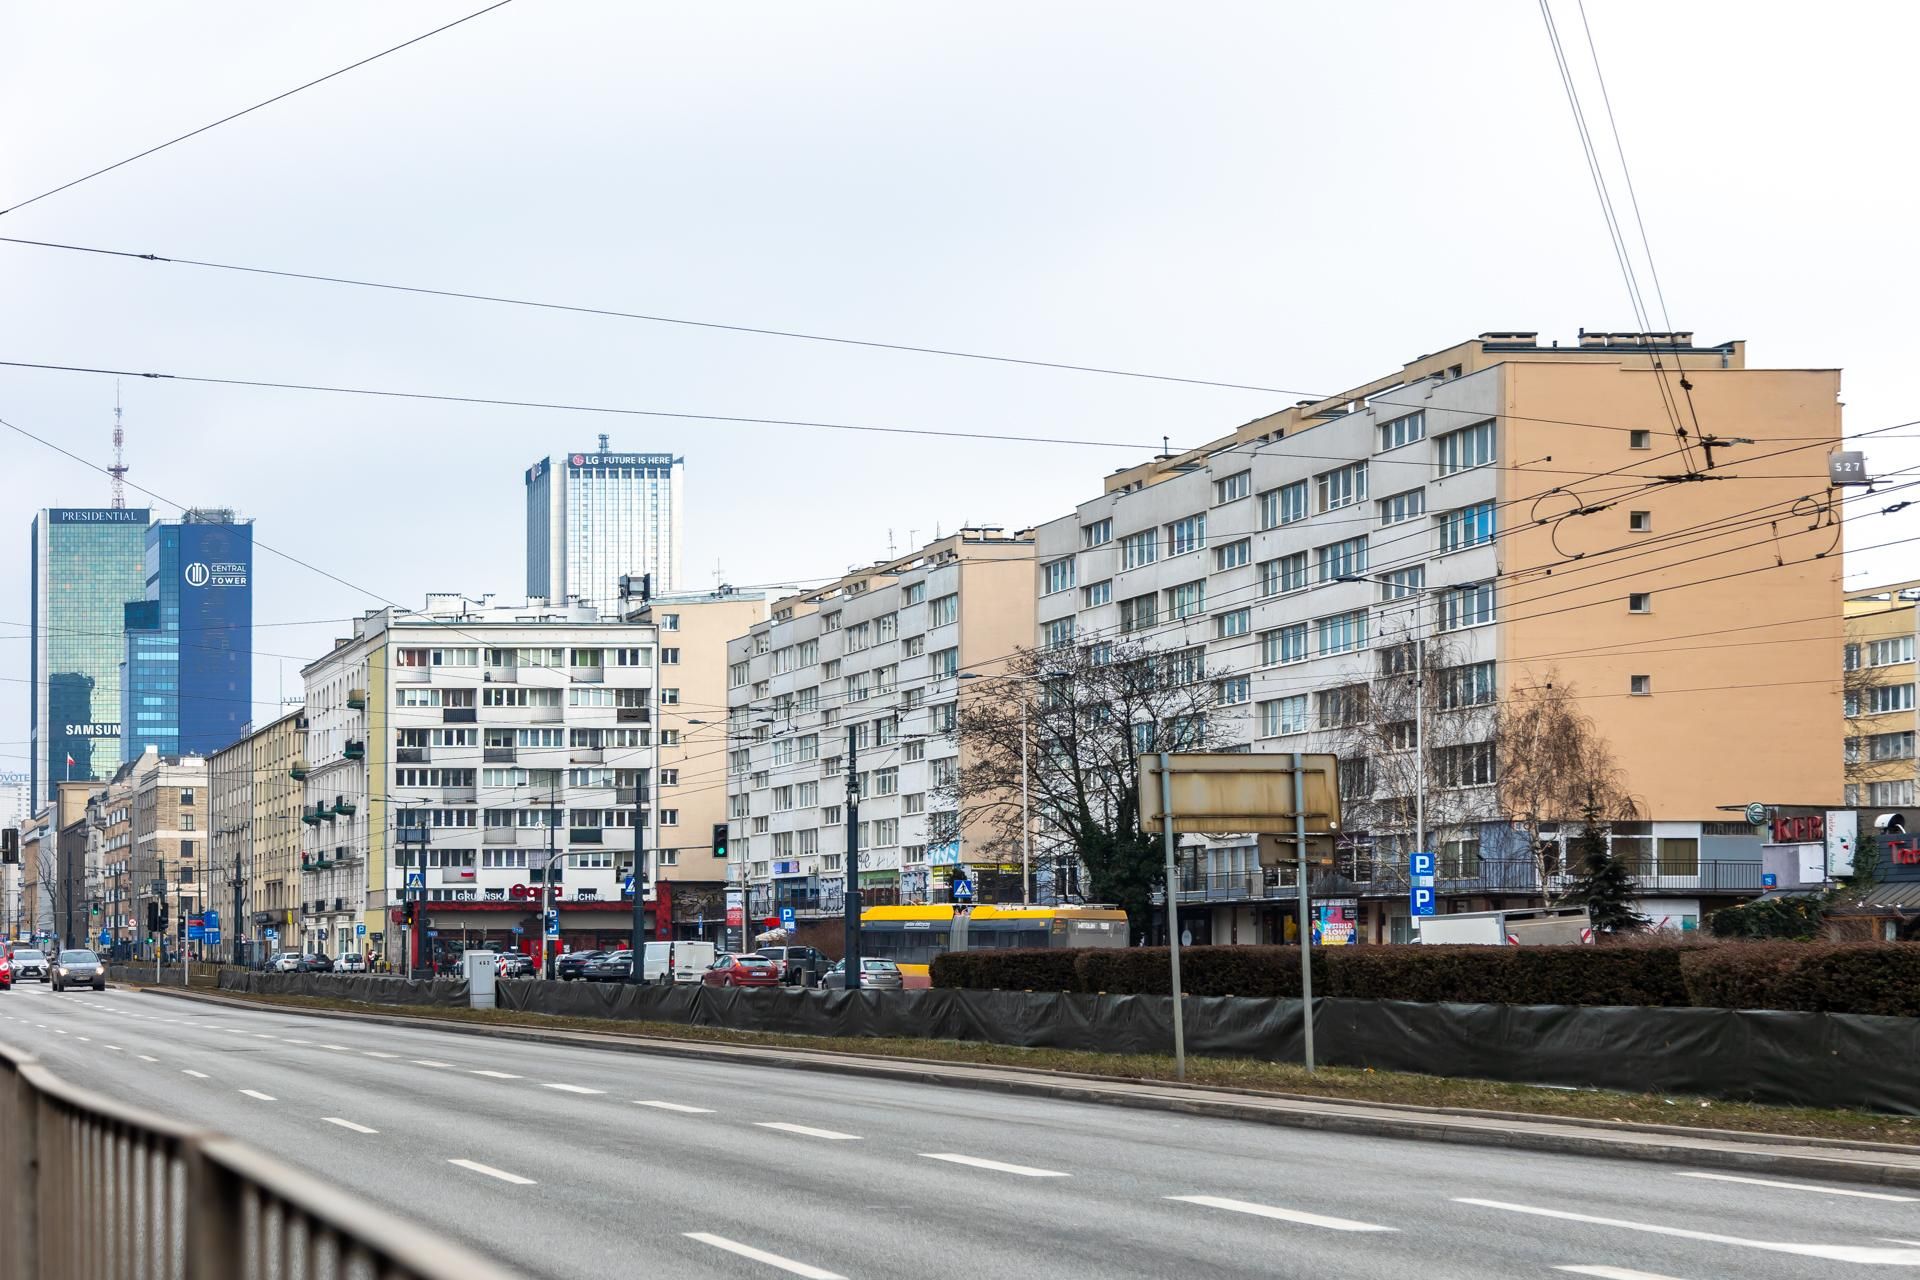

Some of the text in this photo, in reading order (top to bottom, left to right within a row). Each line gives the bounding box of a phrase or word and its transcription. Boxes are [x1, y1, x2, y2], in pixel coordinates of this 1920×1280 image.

[586, 456, 670, 465] LG FUTURE IS HERE
[1834, 462, 1860, 472] 527
[62, 511, 138, 521] PRESIDENTIAL
[1415, 855, 1430, 873] P
[457, 892, 509, 901] GRUŃSK
[1416, 889, 1430, 908] P
[783, 908, 792, 921] P
